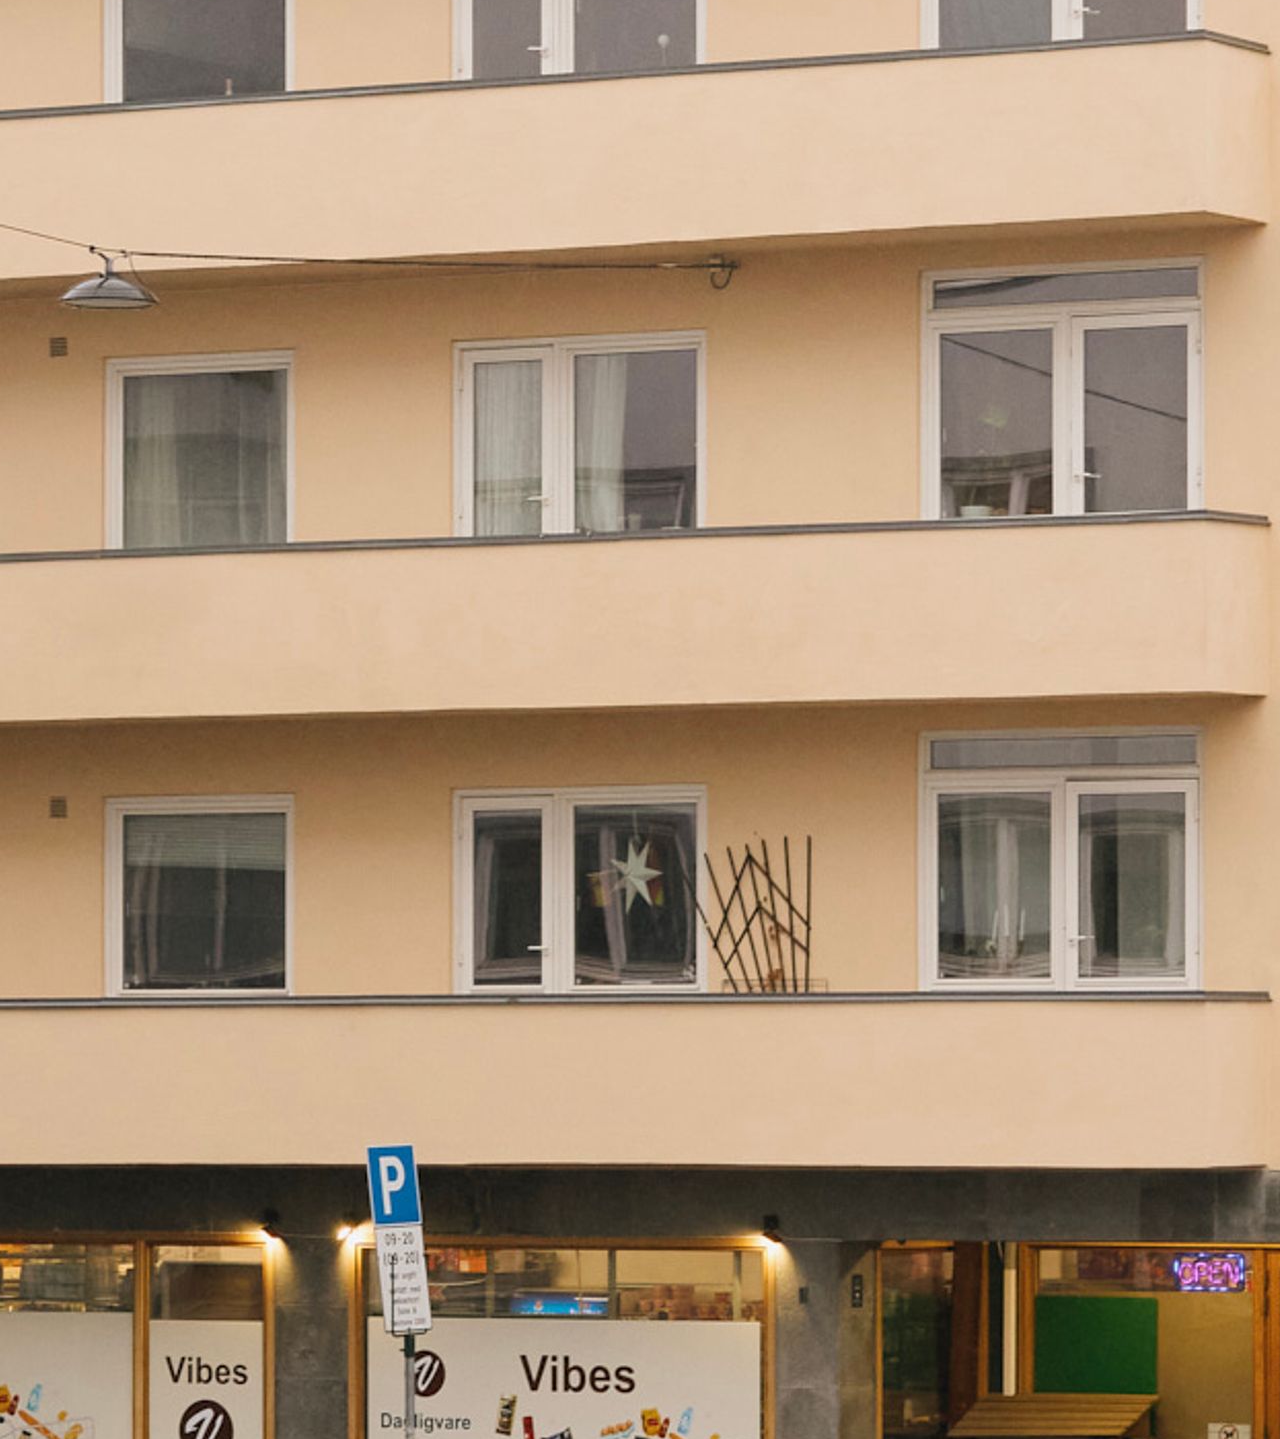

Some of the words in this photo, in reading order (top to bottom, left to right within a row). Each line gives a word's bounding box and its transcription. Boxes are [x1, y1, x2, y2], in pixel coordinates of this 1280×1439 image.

[378, 1155, 405, 1216] P
[1178, 1261, 1240, 1284] OPEN
[165, 1356, 249, 1385] Vibes
[519, 1355, 635, 1393] Vibes
[380, 1412, 471, 1433] Daligvare
